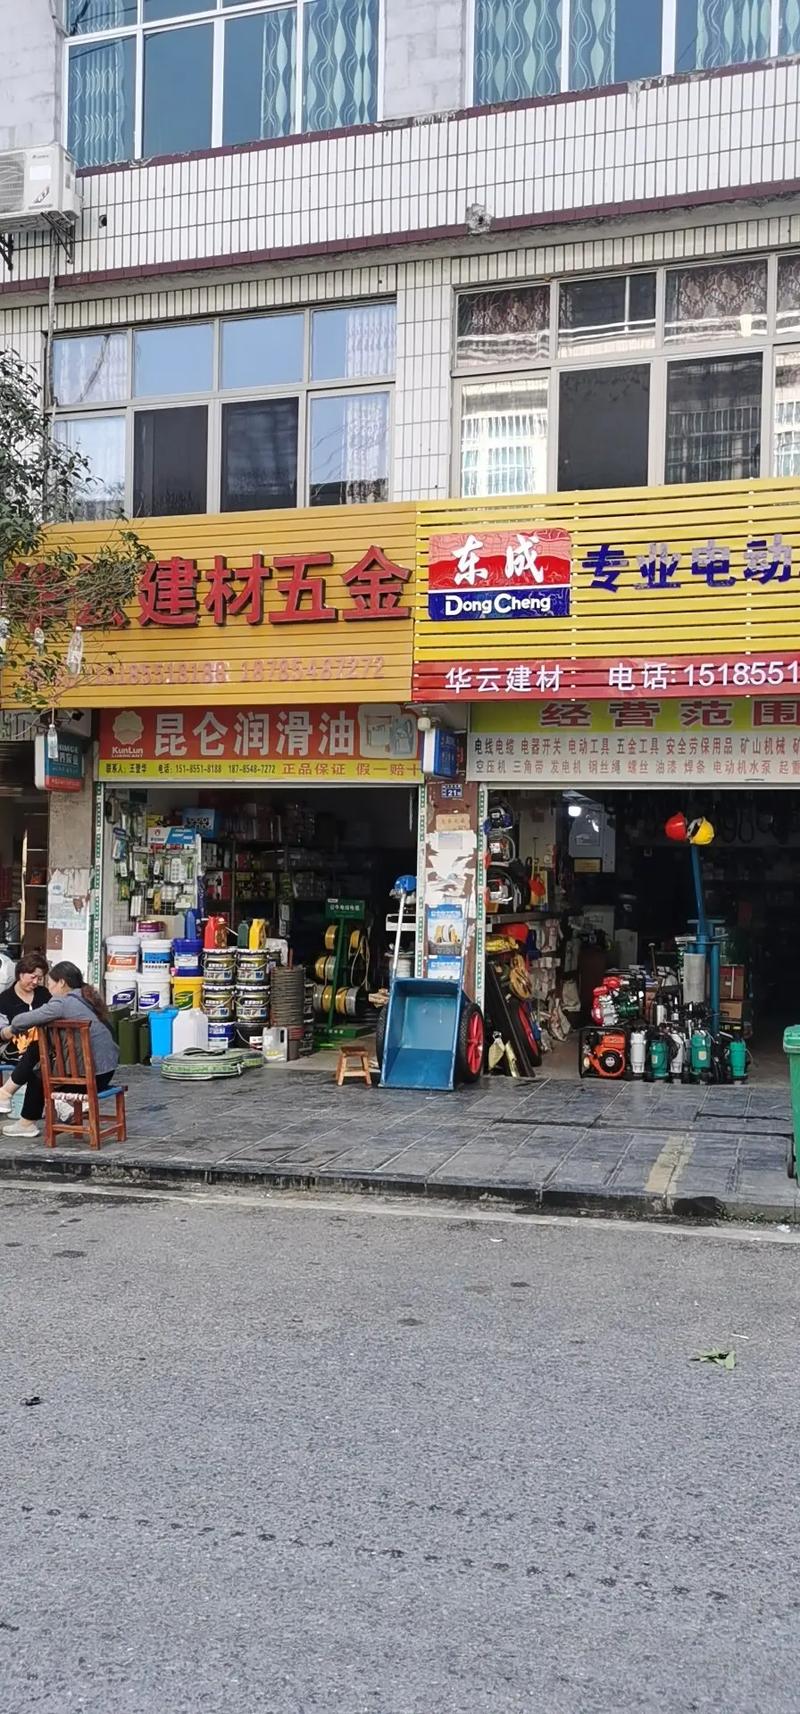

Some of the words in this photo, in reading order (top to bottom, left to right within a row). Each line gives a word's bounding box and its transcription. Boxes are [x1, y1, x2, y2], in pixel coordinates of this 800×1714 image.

[451, 534, 545, 585] 东成
[582, 533, 792, 592] 专业电动
[445, 664, 563, 694] 华云建材
[540, 700, 800, 727] 经营范围
[154, 708, 355, 757] 昆仑润滑油
[474, 738, 515, 755] 电线电缆
[521, 738, 562, 755] 电器开关
[568, 737, 609, 755] 电动工具
[616, 737, 659, 755] 五金工具
[666, 736, 733, 755] 安全劳保用品
[740, 736, 786, 755] 矿山机械
[111, 746, 144, 754] KunLun
[228, 763, 276, 774] 187-8548-7272
[283, 762, 345, 776] 正品保证
[356, 762, 421, 776] 假一赔十
[475, 759, 506, 774] 空压机
[513, 759, 544, 775] 三角带
[551, 759, 581, 775] 发电机
[713, 759, 772, 775] 电动机水泵
